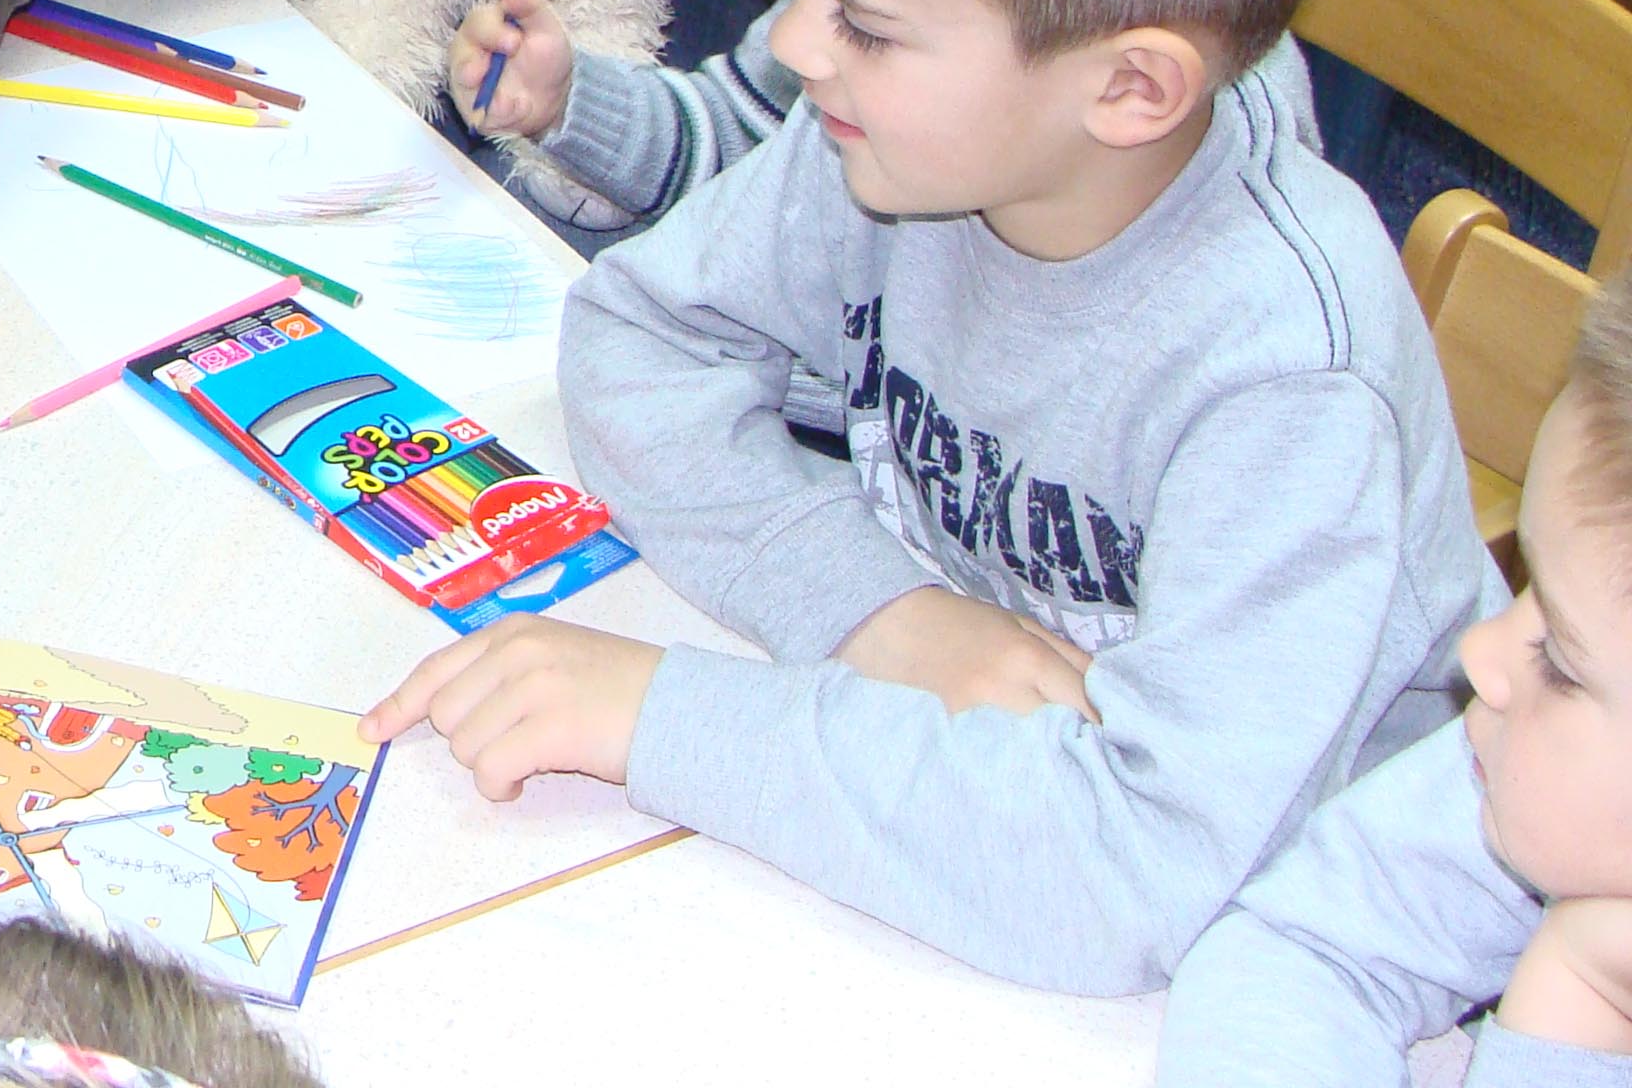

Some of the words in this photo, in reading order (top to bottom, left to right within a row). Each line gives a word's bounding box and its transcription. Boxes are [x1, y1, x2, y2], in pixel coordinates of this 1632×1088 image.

[321, 414, 412, 470] PEPS
[449, 423, 481, 440] 12
[481, 486, 568, 539] Maped
